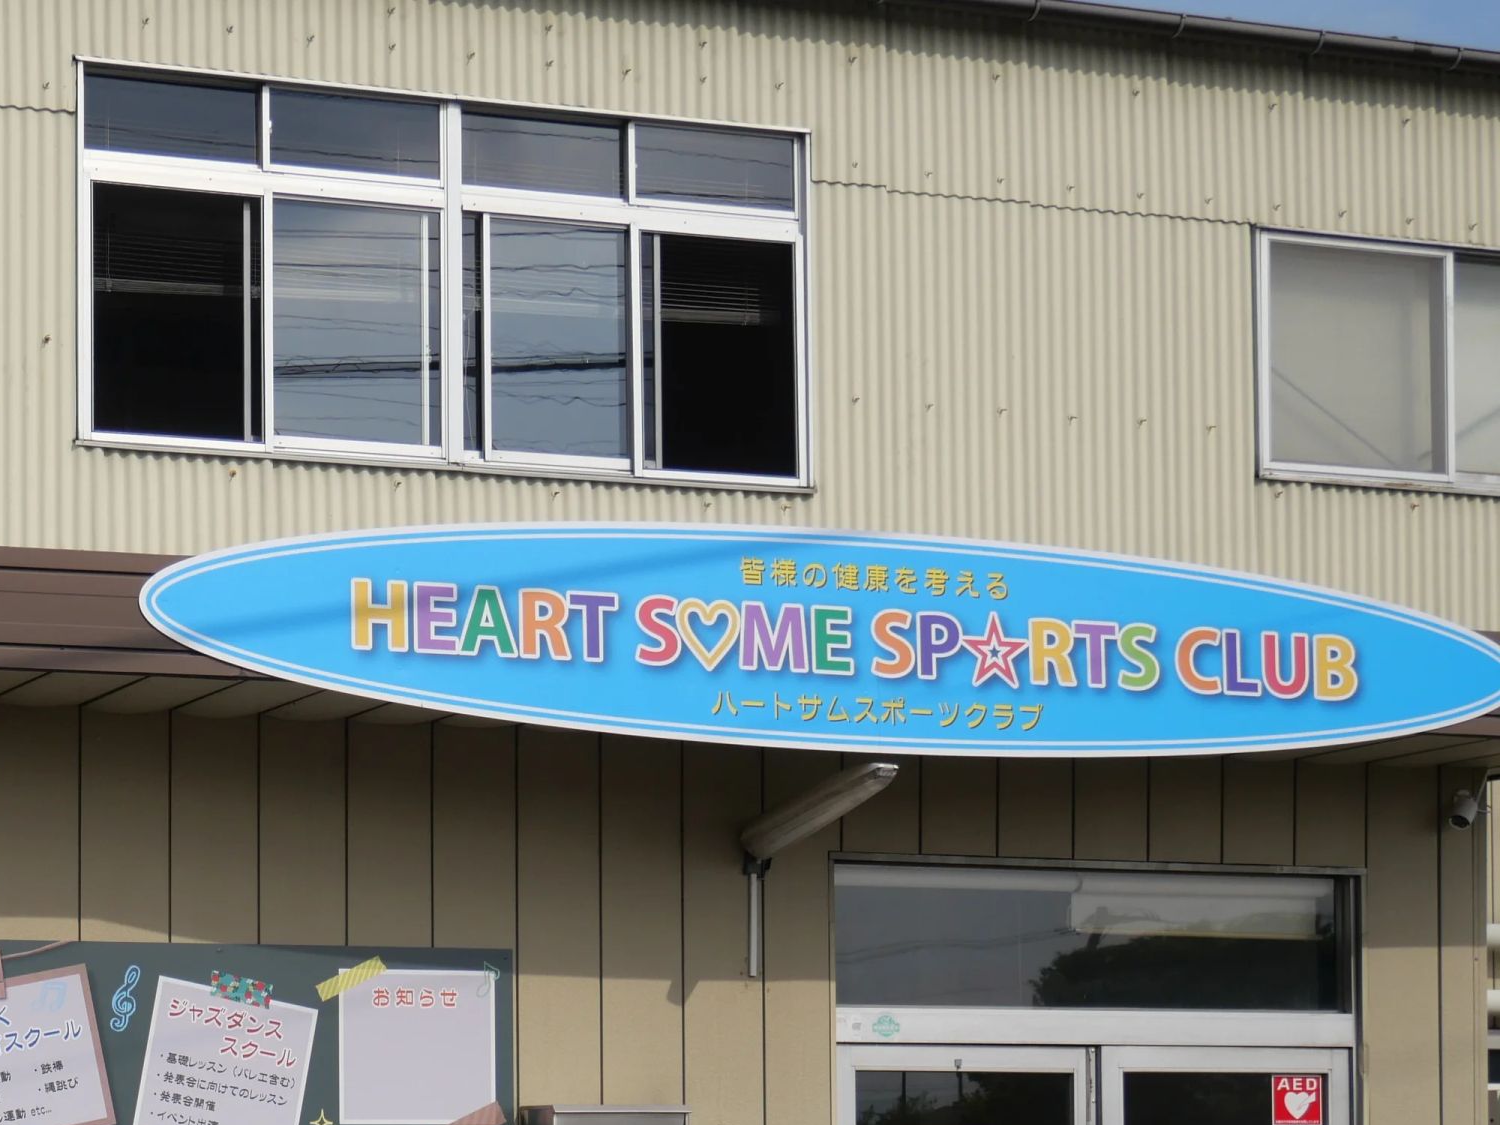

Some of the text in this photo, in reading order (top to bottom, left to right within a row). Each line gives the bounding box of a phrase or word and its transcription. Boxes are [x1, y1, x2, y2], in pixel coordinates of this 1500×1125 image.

[739, 556, 1009, 600] 皆様の健康を考える
[350, 577, 619, 662] HEART
[1175, 626, 1359, 702] CLUB
[711, 690, 1044, 731] ハートサムスポーツクラブ
[372, 987, 458, 1008] お知らせ
[168, 999, 283, 1040] ジャズダンス
[220, 1036, 298, 1068] スクール
[1277, 1077, 1318, 1091] AED
